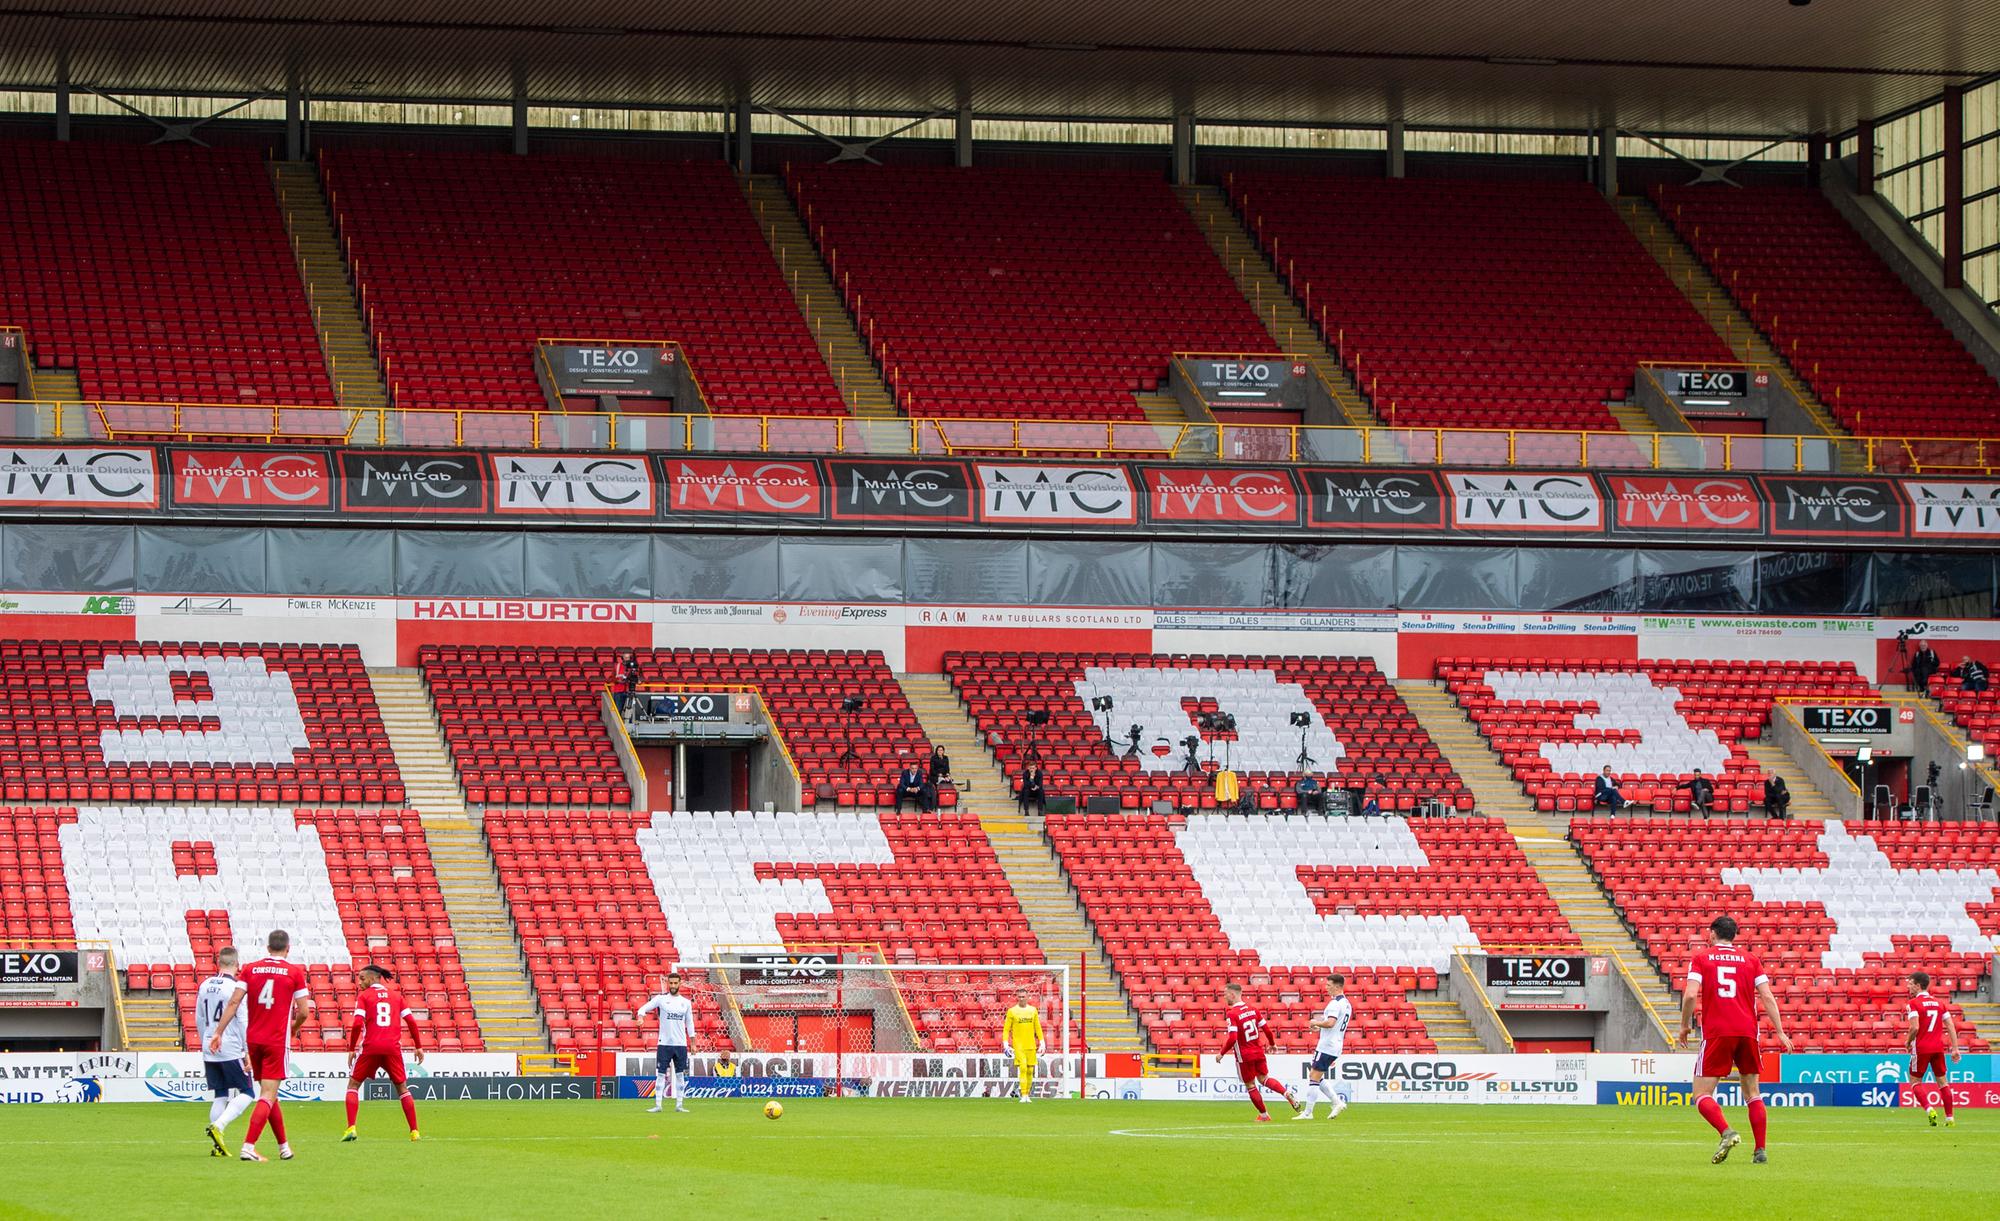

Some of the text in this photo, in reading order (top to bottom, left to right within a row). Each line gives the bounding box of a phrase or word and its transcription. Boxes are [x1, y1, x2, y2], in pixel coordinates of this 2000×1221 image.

[578, 349, 639, 367] TEXO
[660, 352, 675, 362] 43
[1212, 363, 1270, 381] TEXO
[1292, 365, 1306, 374] 46
[1677, 373, 1734, 390] TEXO
[1755, 375, 1768, 384] 48
[1, 464, 151, 475] Contract Hire Division
[182, 465, 320, 479] murison.co.uk
[375, 470, 452, 482] MuriCab
[502, 472, 647, 484] Contract Hire Division
[676, 473, 811, 487] murison.co.uk
[864, 478, 939, 490] MuriCab
[987, 481, 1128, 492] Contract Hire Division
[1156, 482, 1287, 495] murison.co.uk
[1338, 486, 1411, 498] MuriCab
[1457, 489, 1596, 500] Contract Hire Division
[1622, 490, 1750, 503] murison.co.uk
[1800, 495, 1872, 507] MuriCab
[81, 596, 123, 615] ACE
[414, 601, 637, 622] HALLIBURTON
[671, 605, 763, 617] The Press and Journal
[982, 613, 1142, 624] RAM TUBULARS SCOTLAND LTD
[1156, 615, 1186, 624] DALES
[1229, 616, 1259, 625] DALES
[1300, 617, 1356, 626] GILLANDERS
[1658, 617, 1696, 629] WASTE
[1701, 618, 1817, 629] www.eiswaste.com
[1401, 621, 1426, 630] Stena
[1426, 621, 1455, 631] Drilling
[1462, 622, 1516, 632] Stena Drilling
[1523, 623, 1577, 633] Stena Drilling
[1583, 623, 1637, 633] Stena Drilling
[1837, 620, 1874, 631] WASTE
[650, 695, 714, 714] XO
[736, 698, 750, 710] 44
[1817, 708, 1878, 726] TEXO
[1899, 710, 1913, 720] 49
[0, 953, 61, 974] EXO
[87, 955, 105, 969] 42
[756, 956, 827, 977] TEXO
[1502, 958, 1570, 978] TEXO
[1591, 961, 1607, 973] 47
[1716, 966, 1737, 998] 5
[258, 978, 275, 1010] 4
[376, 1002, 391, 1027] 8
[1926, 1009, 1938, 1032] 7
[79, 1055, 136, 1075] BRIDGE
[1341, 1061, 1457, 1081] SWACO
[1631, 1058, 1656, 1075] THE
[167, 1080, 208, 1092] Saltire
[285, 1080, 325, 1092] Saltire
[487, 1083, 582, 1101] HOMES
[740, 1084, 774, 1095] 01224
[775, 1084, 817, 1095] 877575
[876, 1080, 1060, 1098] KENWAY TYES
[1177, 1079, 1208, 1093] Bell
[1376, 1080, 1469, 1092] ROLLSTUD
[1486, 1081, 1578, 1092] ROLLSTUD
[1861, 1086, 1896, 1107] sky
